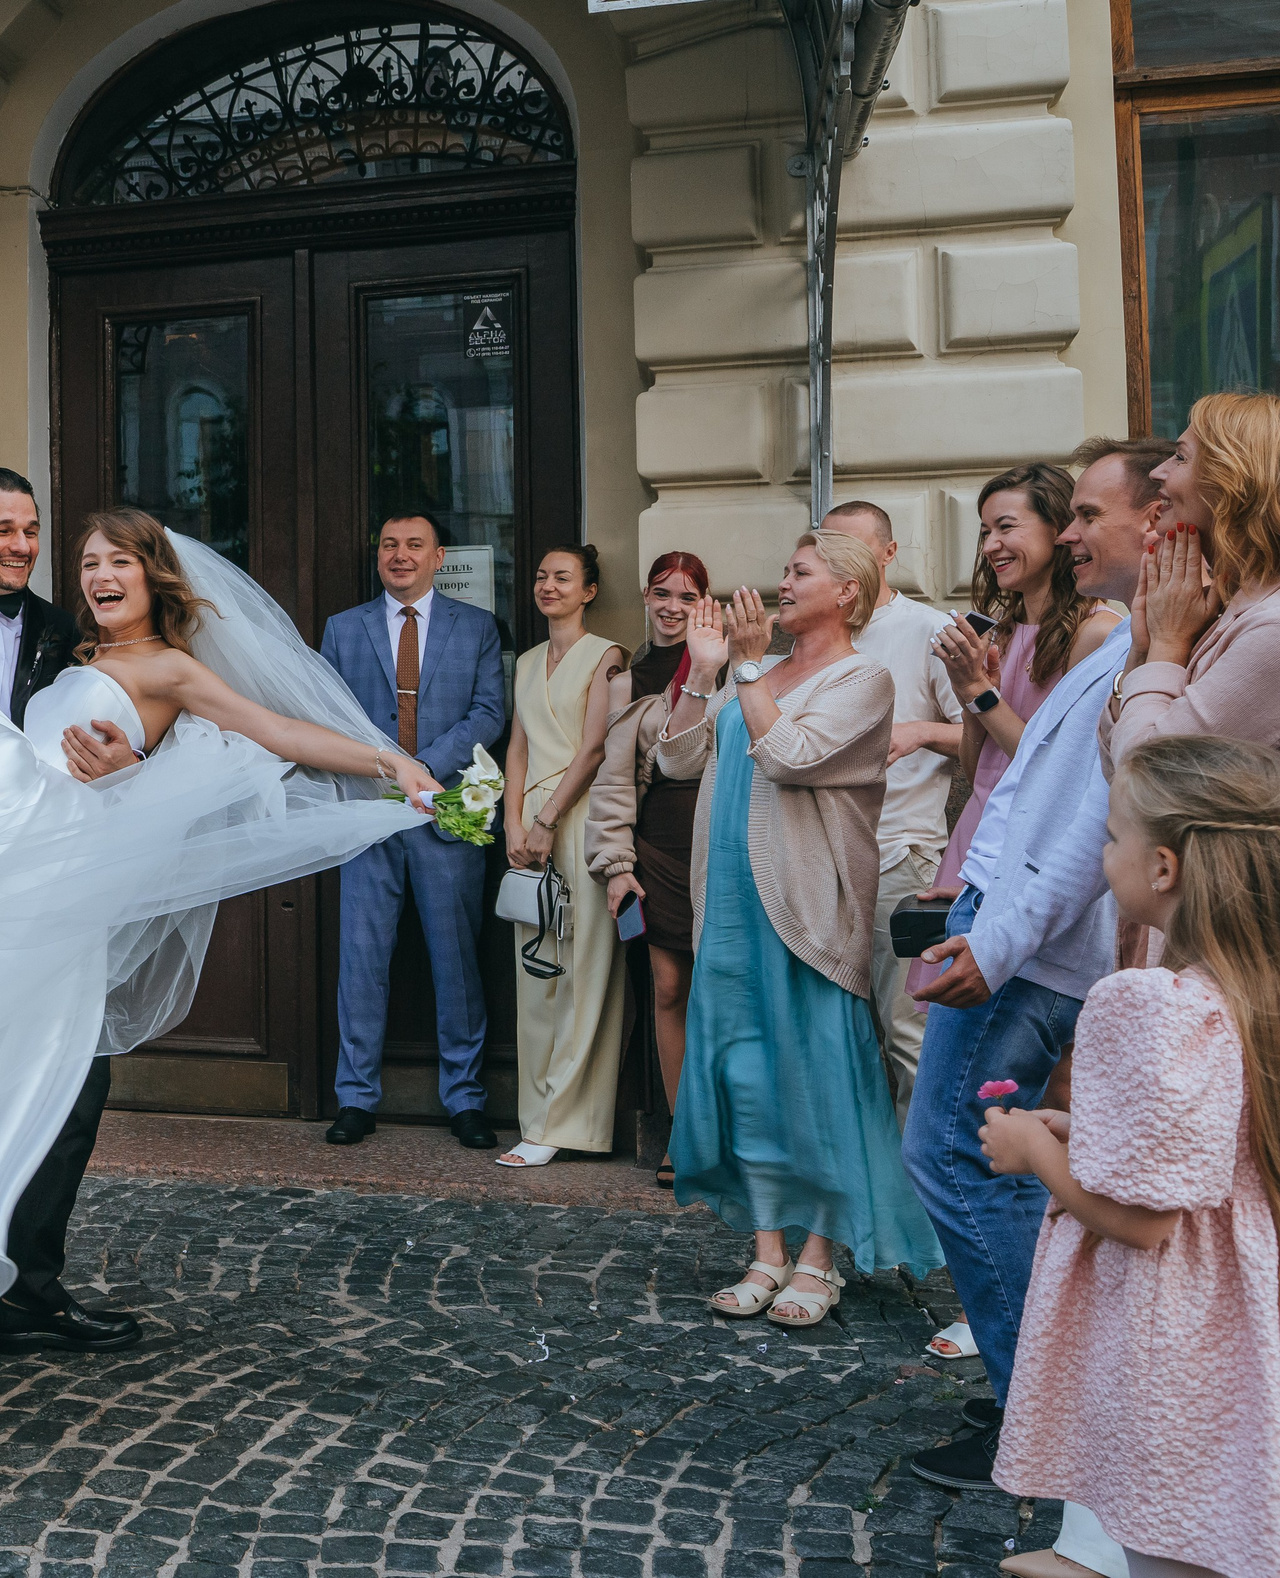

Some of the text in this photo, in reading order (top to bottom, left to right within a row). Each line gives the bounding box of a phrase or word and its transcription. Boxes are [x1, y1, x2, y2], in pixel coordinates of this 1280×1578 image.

[468, 330, 506, 339] ALPHA
[468, 336, 506, 346] SECTOR
[437, 581, 470, 591] дворе
